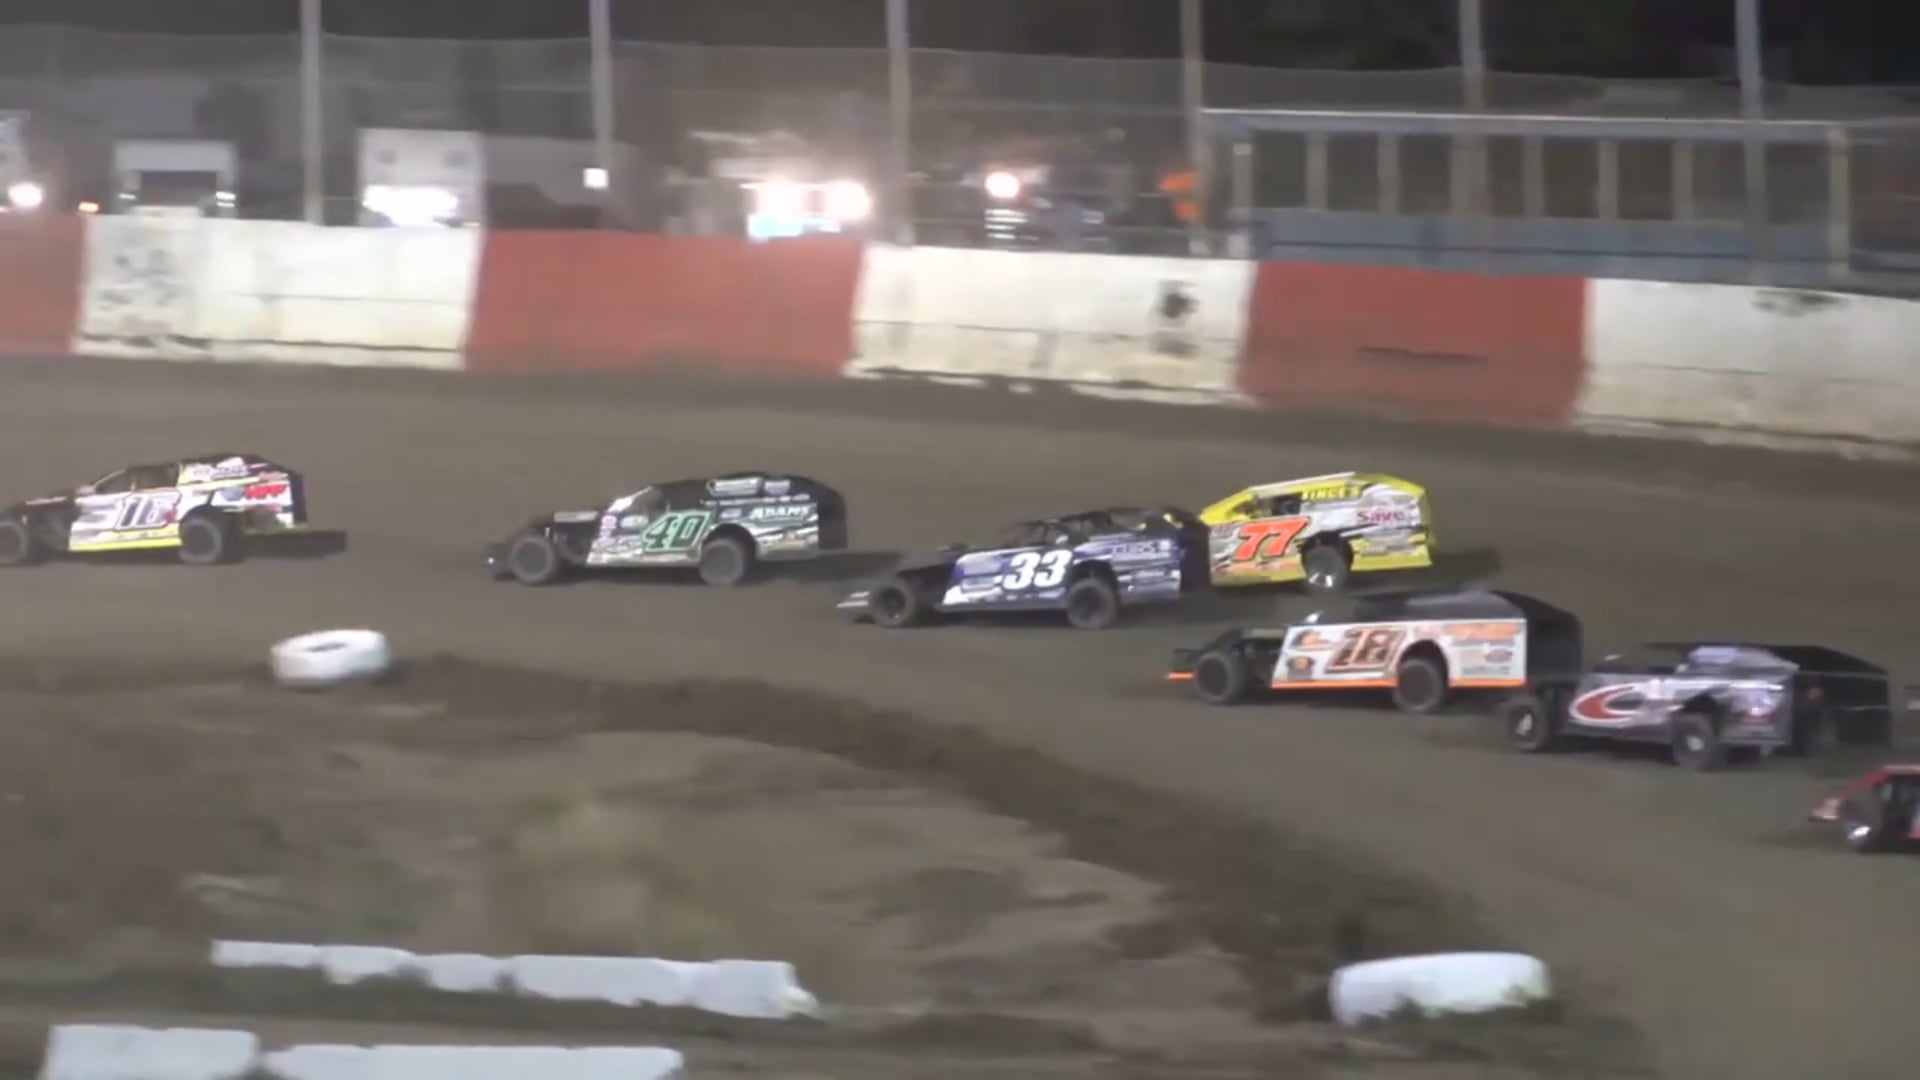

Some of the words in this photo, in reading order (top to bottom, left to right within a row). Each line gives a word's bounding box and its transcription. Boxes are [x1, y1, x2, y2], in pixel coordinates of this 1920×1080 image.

[642, 510, 714, 552] 40
[749, 504, 812, 521] ADAMS
[1231, 516, 1311, 562] 77
[1002, 549, 1073, 590] 33
